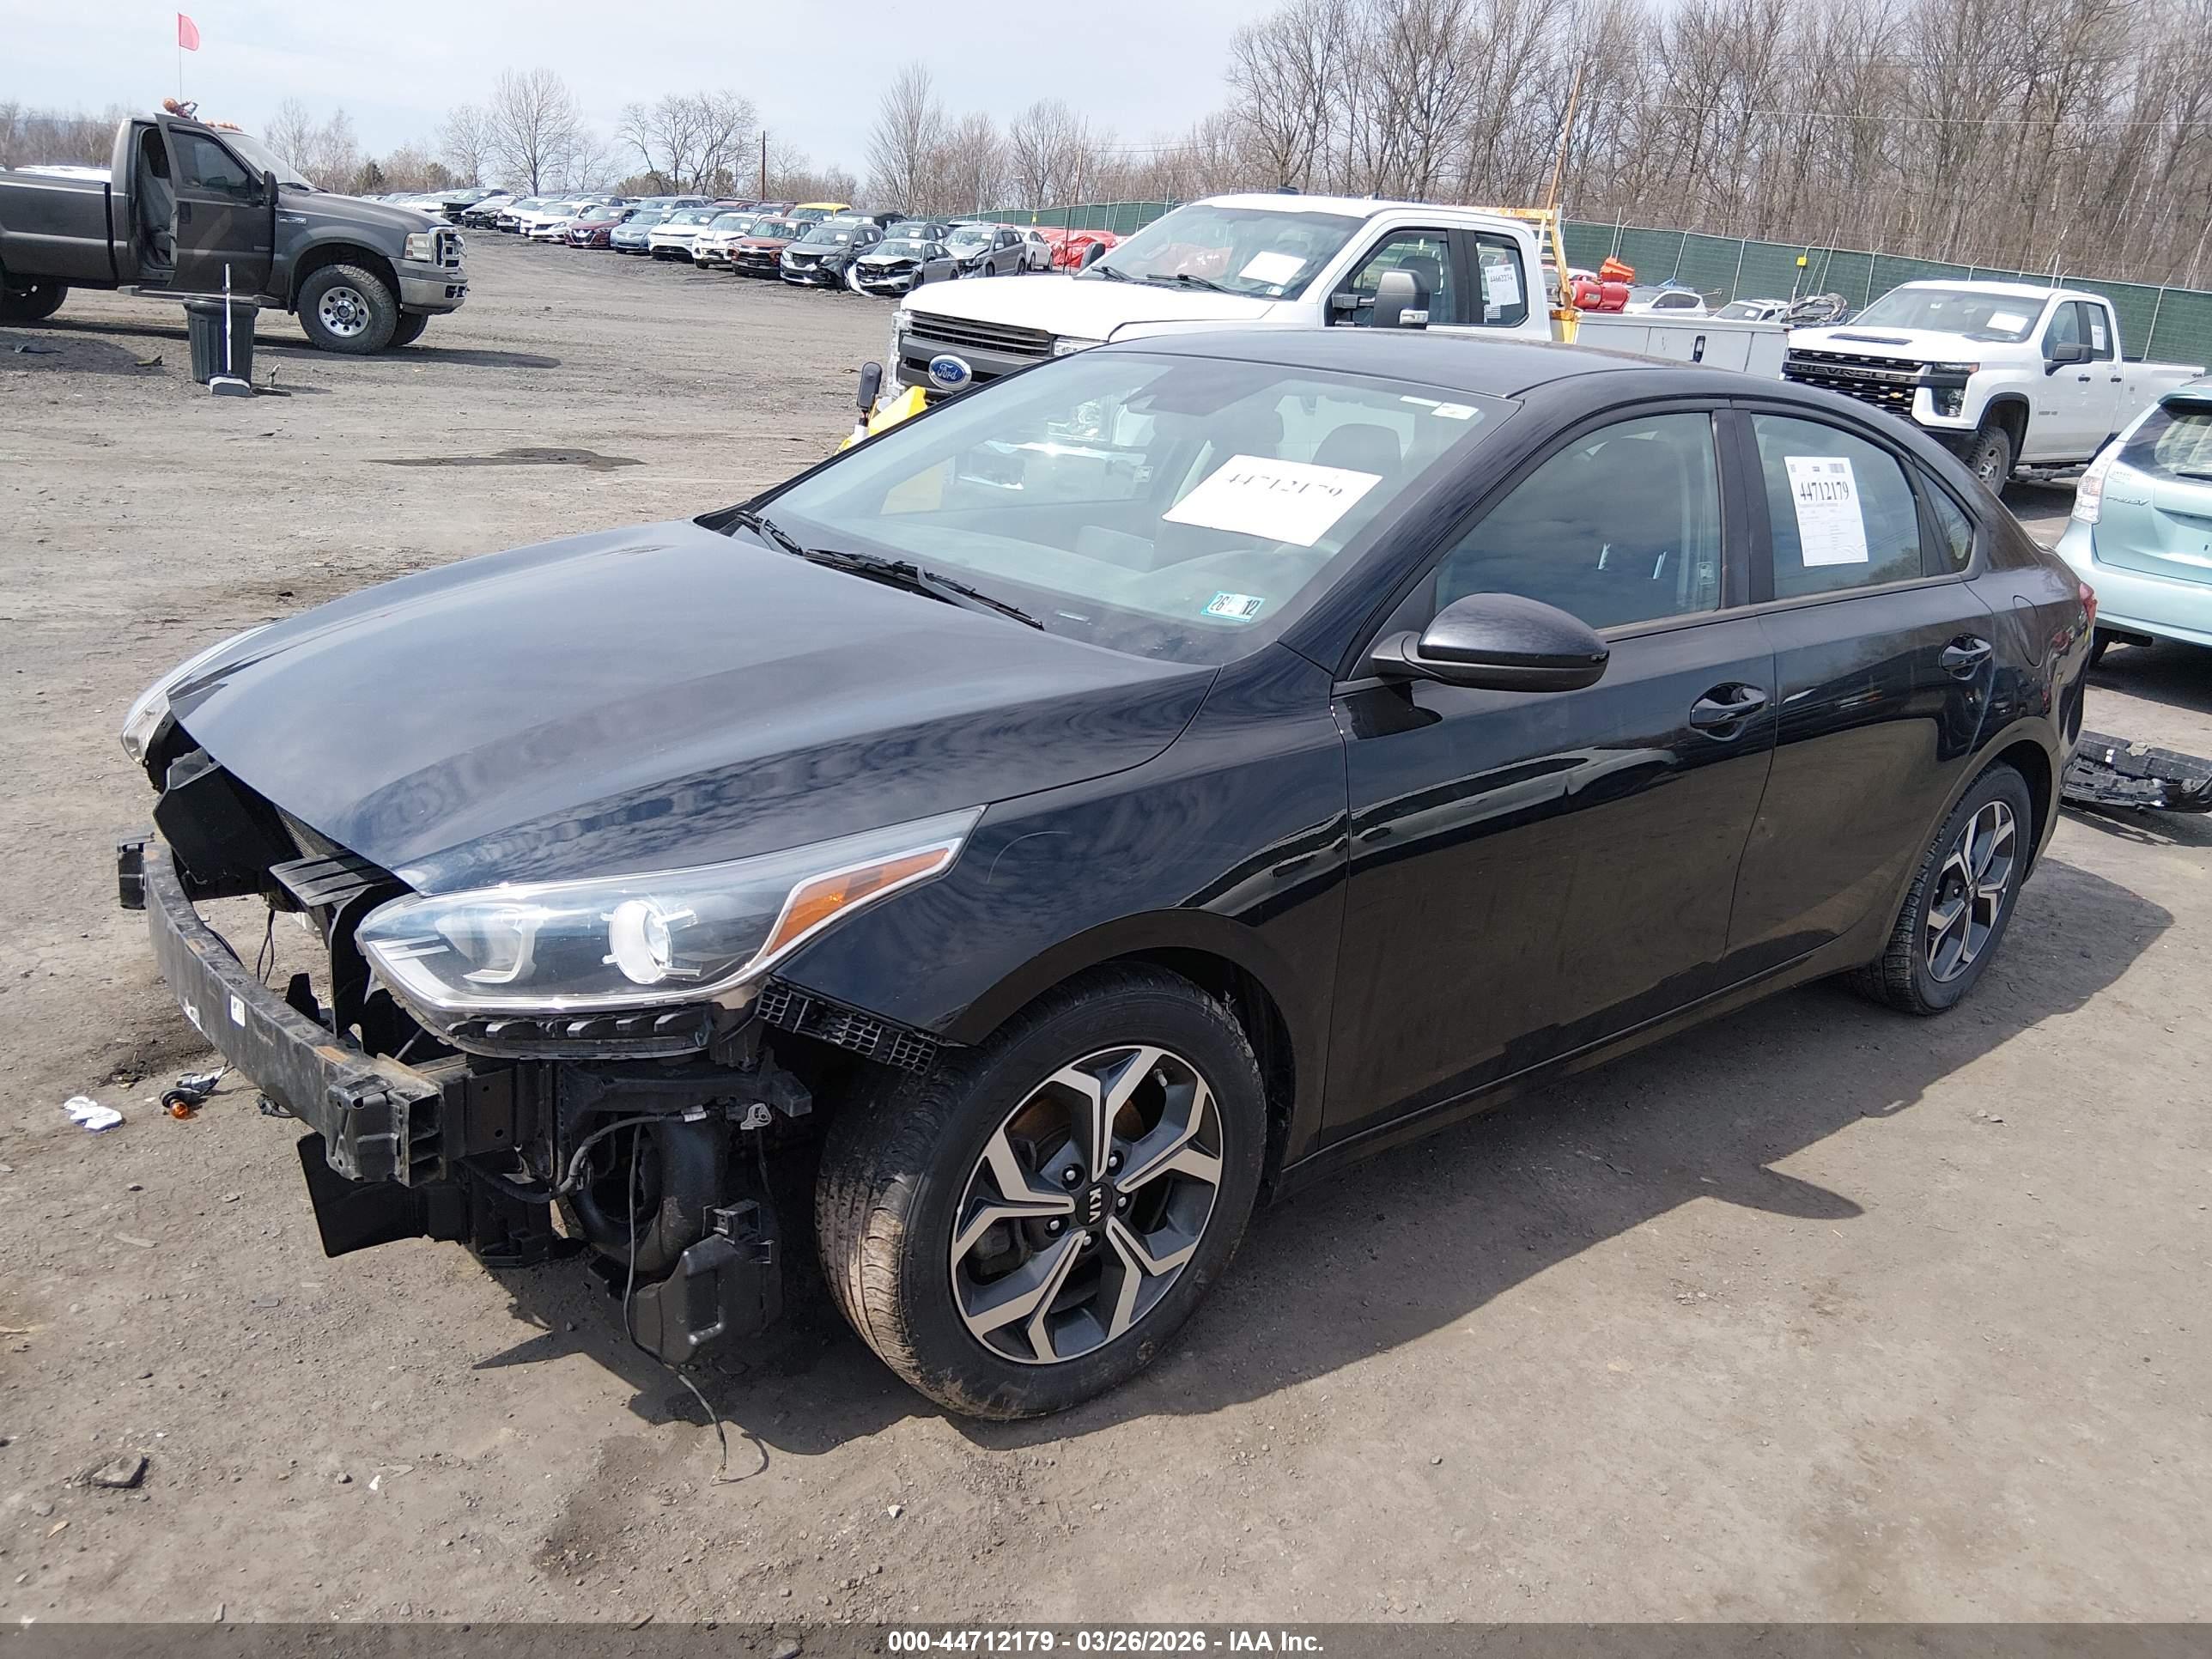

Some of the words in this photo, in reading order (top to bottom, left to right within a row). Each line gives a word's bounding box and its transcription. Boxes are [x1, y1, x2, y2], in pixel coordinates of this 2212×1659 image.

[937, 362, 959, 380] Ford
[1800, 481, 1850, 501] 44712179
[1210, 595, 1230, 611] 26
[1241, 599, 1261, 616] 12
[1089, 1187, 1102, 1223] KIA
